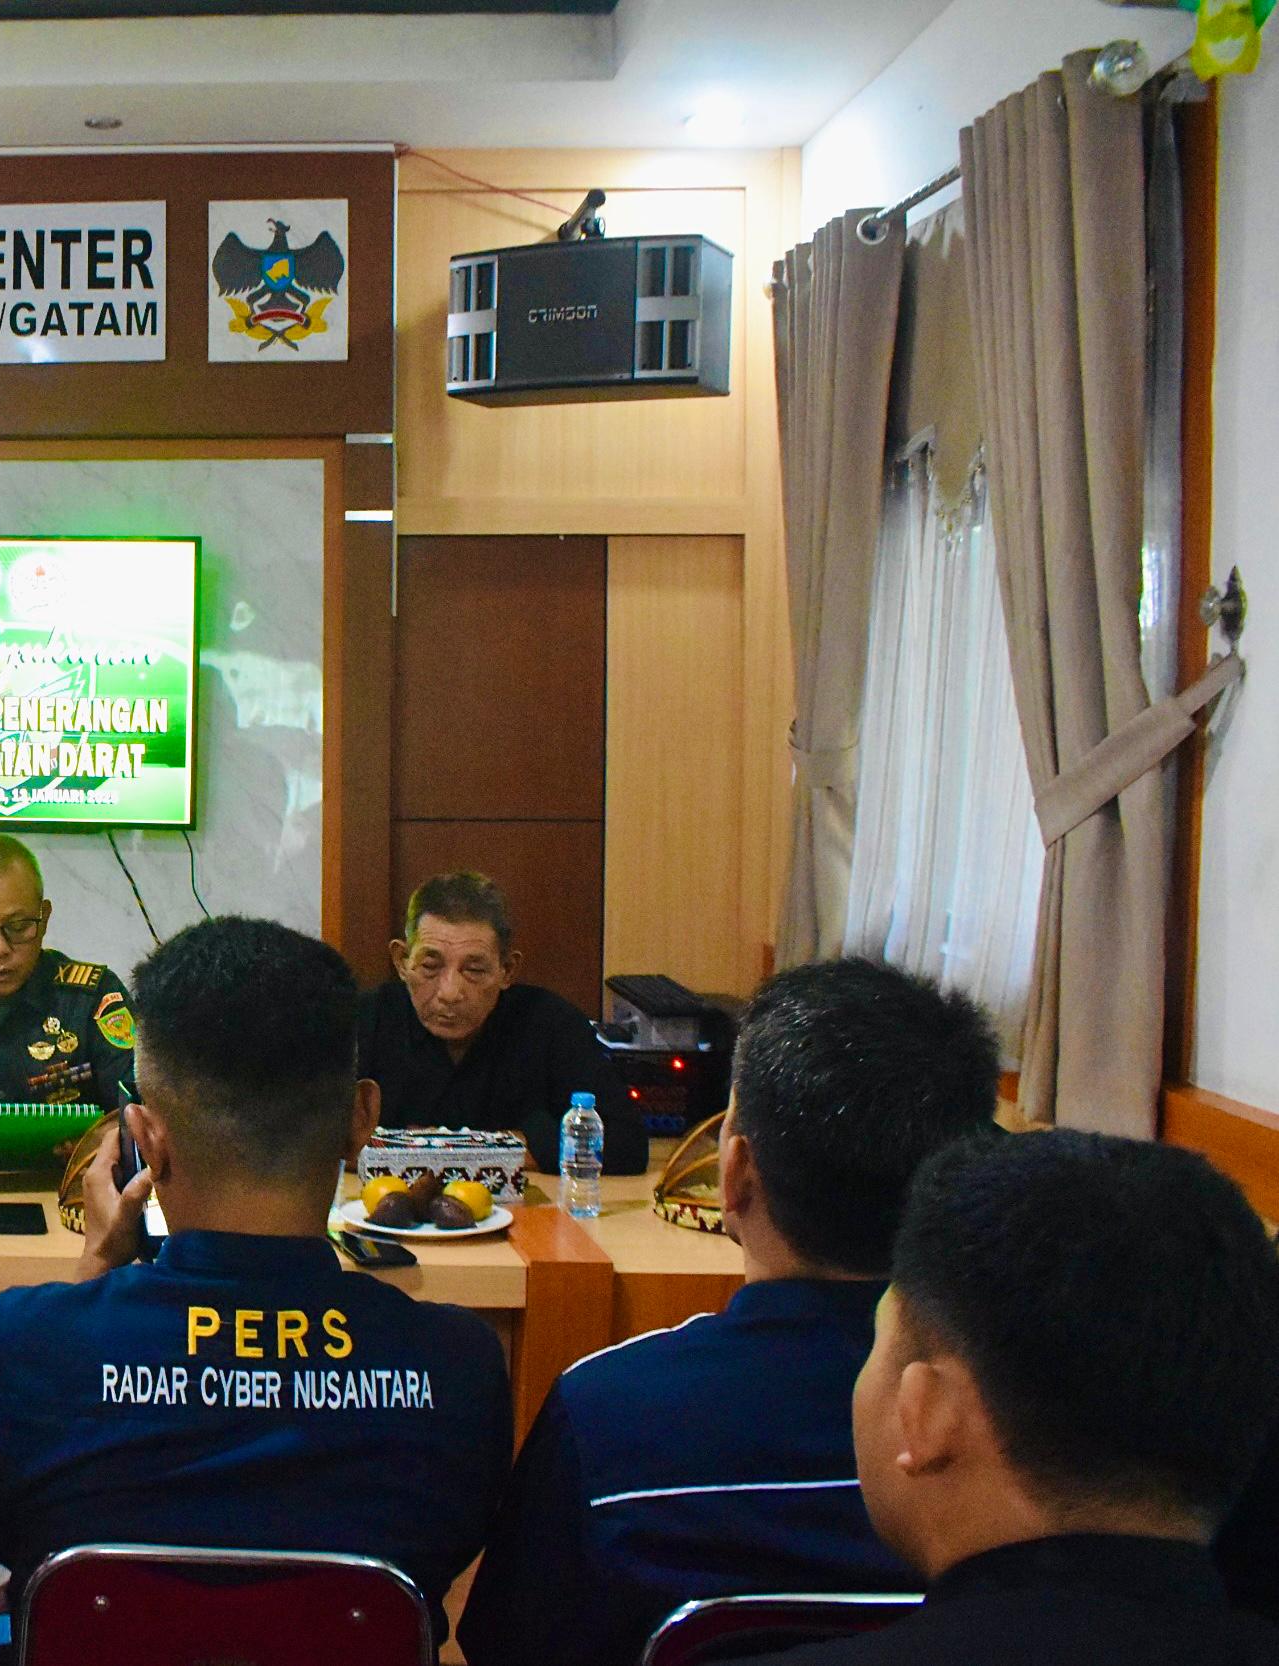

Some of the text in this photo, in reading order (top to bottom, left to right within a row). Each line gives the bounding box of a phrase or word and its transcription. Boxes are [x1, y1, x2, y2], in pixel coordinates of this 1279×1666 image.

[58, 743, 146, 778] DARAT
[187, 1306, 353, 1359] PERS
[102, 1364, 434, 1409] RADAR CYBER NUSANTARA
